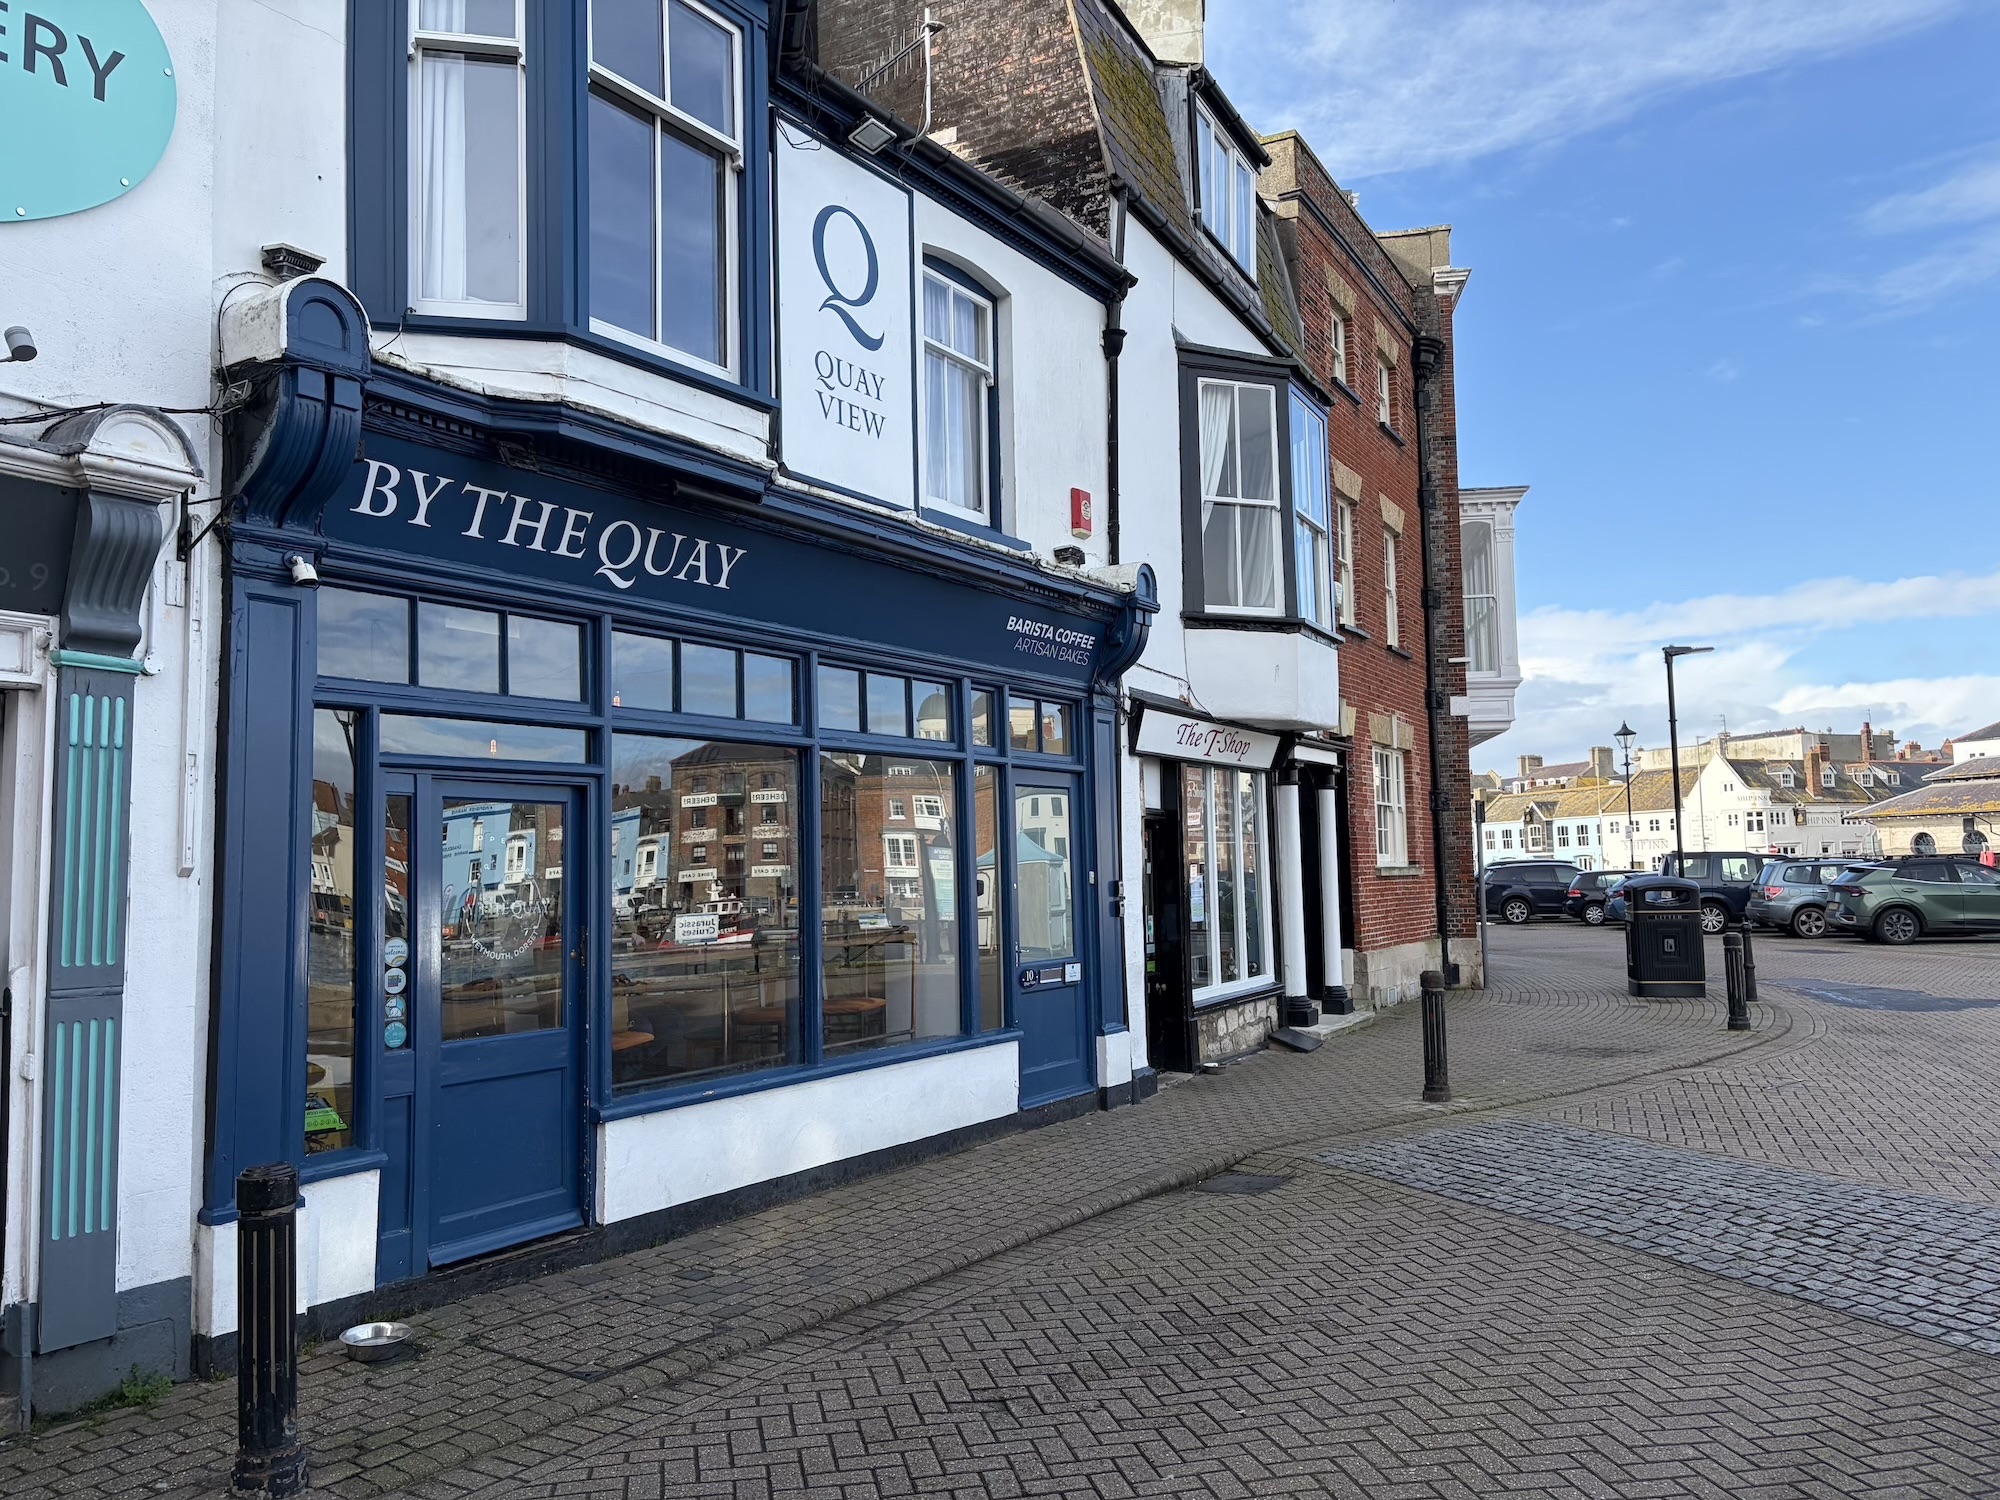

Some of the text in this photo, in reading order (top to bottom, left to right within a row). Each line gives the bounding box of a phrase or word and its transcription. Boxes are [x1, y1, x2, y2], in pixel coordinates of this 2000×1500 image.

[0, 0, 126, 102] RY
[811, 204, 886, 352] Q
[814, 350, 886, 402] QUAY
[814, 388, 887, 440] VIEW
[349, 457, 748, 590] BY THE QUAY
[30, 562, 49, 591] 9
[1006, 615, 1096, 650] BARISTA COFFEE
[1013, 636, 1090, 666] ARTISAN BAKES
[1176, 722, 1251, 762] The T-Shop
[1807, 815, 1836, 824] HIP INN
[1623, 840, 1668, 850] SHIP INN
[514, 929, 539, 957] DORSET
[1026, 969, 1034, 982] 10
